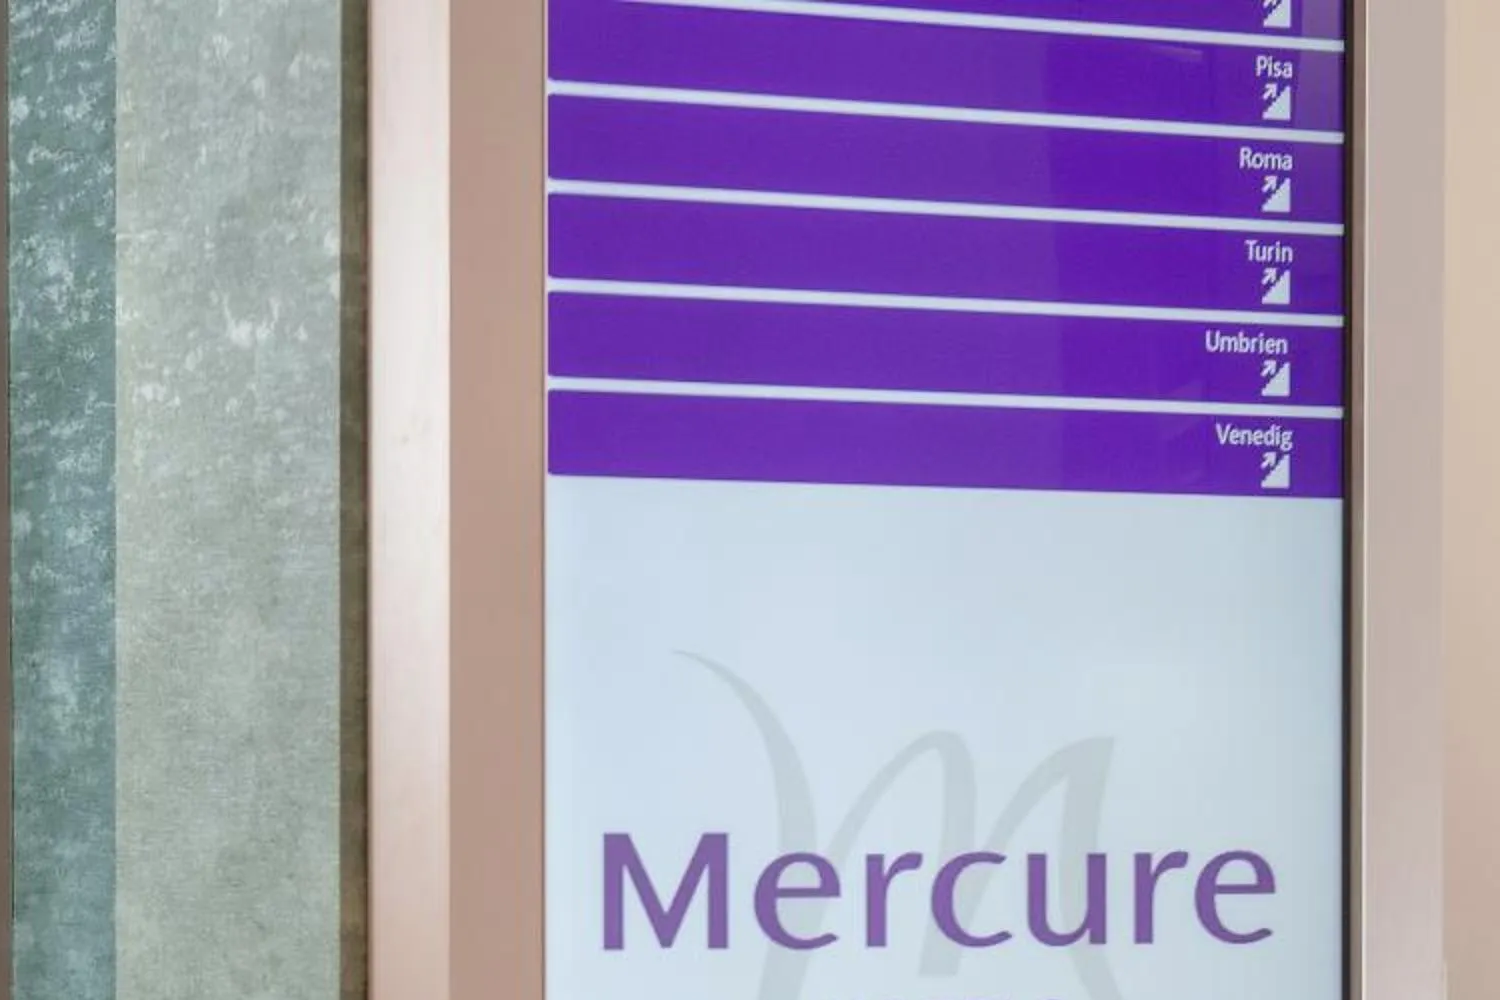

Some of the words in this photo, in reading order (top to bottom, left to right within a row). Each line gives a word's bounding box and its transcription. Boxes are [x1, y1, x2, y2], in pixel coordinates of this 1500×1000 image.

[1255, 55, 1293, 78] Pisa
[1239, 146, 1293, 171] Roma
[1245, 240, 1293, 263] Turin
[1205, 331, 1288, 355] Umbrien
[1215, 423, 1293, 452] Venedig
[602, 831, 1277, 952] Mercure
